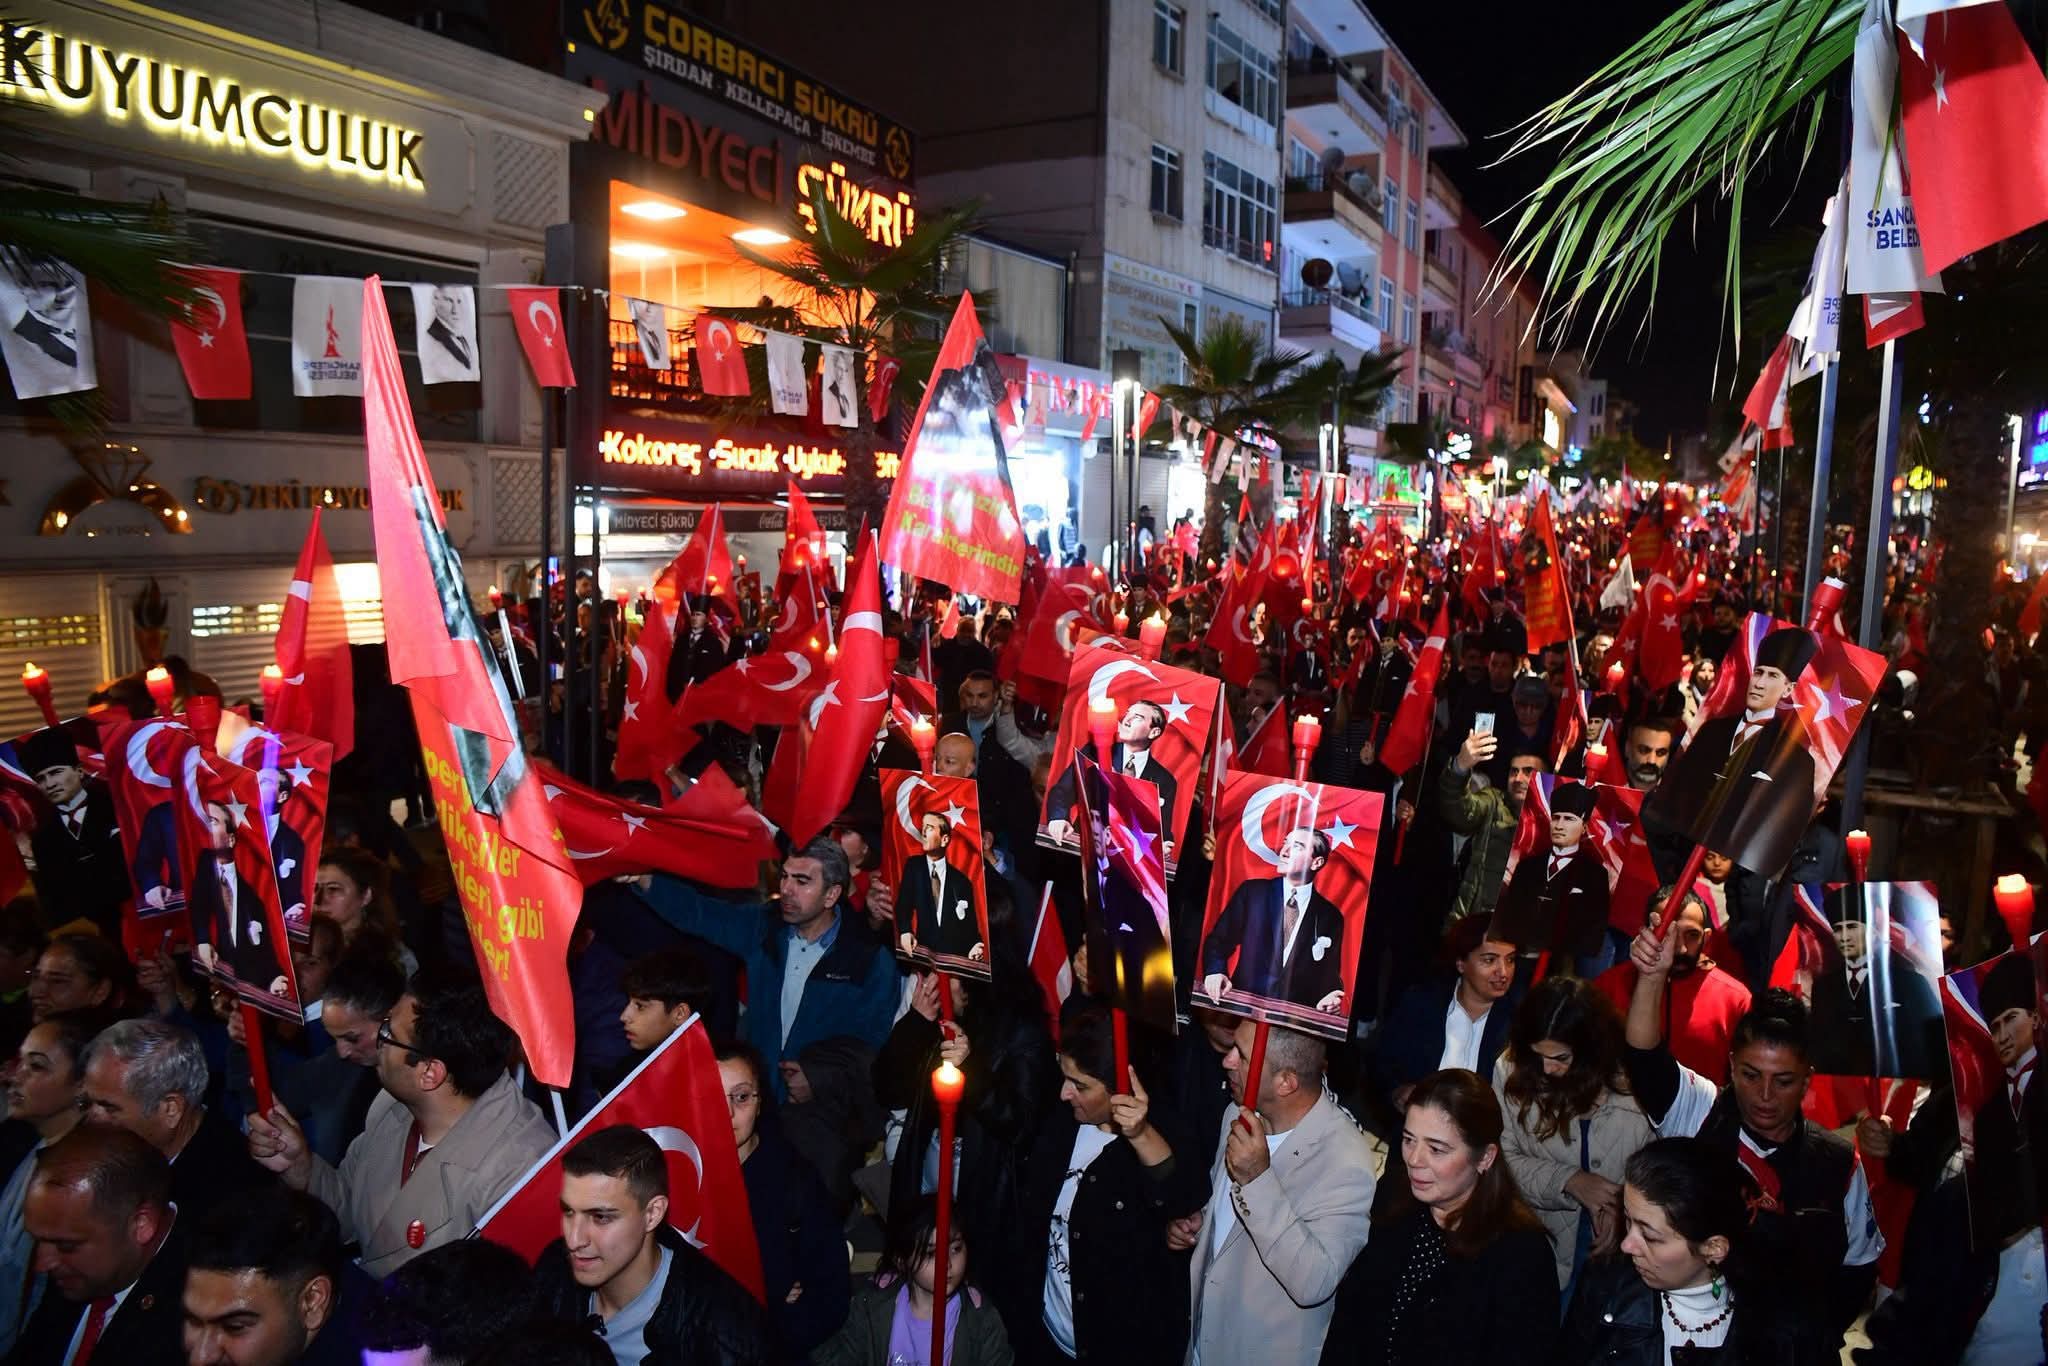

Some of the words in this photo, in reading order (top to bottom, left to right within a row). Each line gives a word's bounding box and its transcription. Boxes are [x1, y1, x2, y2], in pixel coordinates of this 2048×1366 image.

[643, 3, 784, 99] ÇORBACI
[3, 23, 425, 184] KUYUMCULUK
[725, 80, 811, 137] KELLEPAÇA
[591, 75, 784, 203] MİDYECİ
[1866, 206, 1917, 228] SANCA
[1877, 228, 1921, 250] BELED
[604, 431, 701, 475] Kokoreç
[715, 439, 779, 473] Sucuk
[614, 512, 658, 528] MİDYECİ
[660, 512, 694, 531] ŞÜKRÜ
[497, 898, 545, 944] gibi
